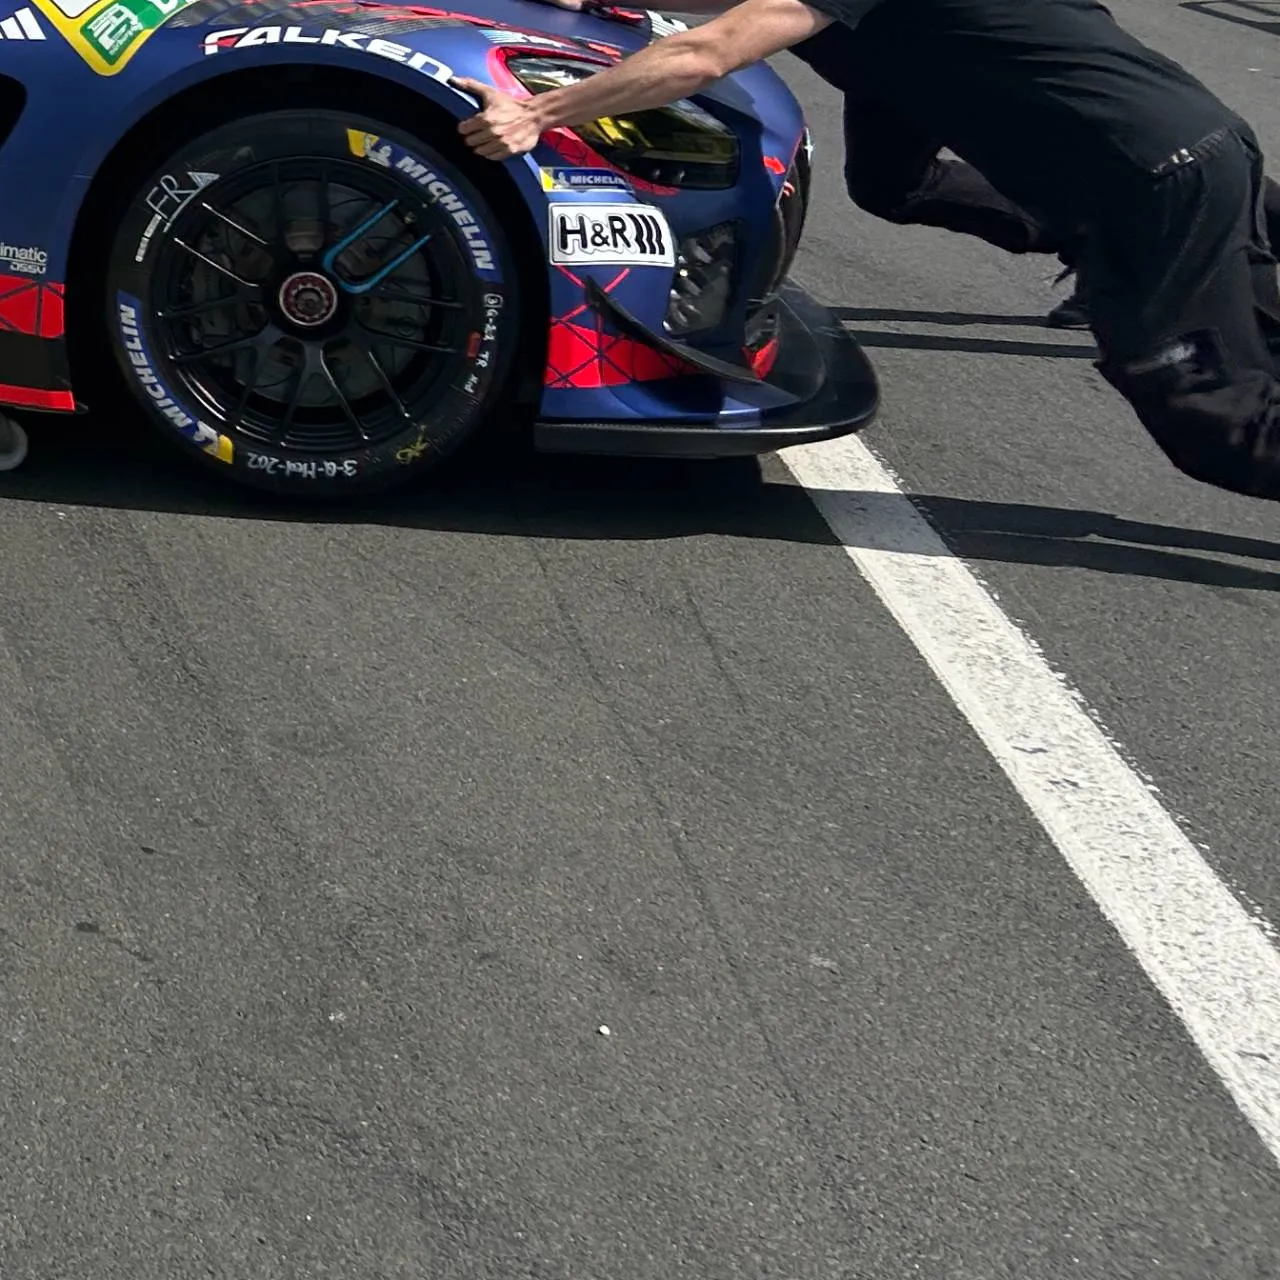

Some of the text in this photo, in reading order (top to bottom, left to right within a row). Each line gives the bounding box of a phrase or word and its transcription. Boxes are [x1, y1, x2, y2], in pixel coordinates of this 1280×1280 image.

[397, 155, 497, 271] MICHELIN
[570, 175, 625, 185] MICHELIN
[559, 214, 631, 251] H&R
[119, 303, 193, 430] MICHELIN
